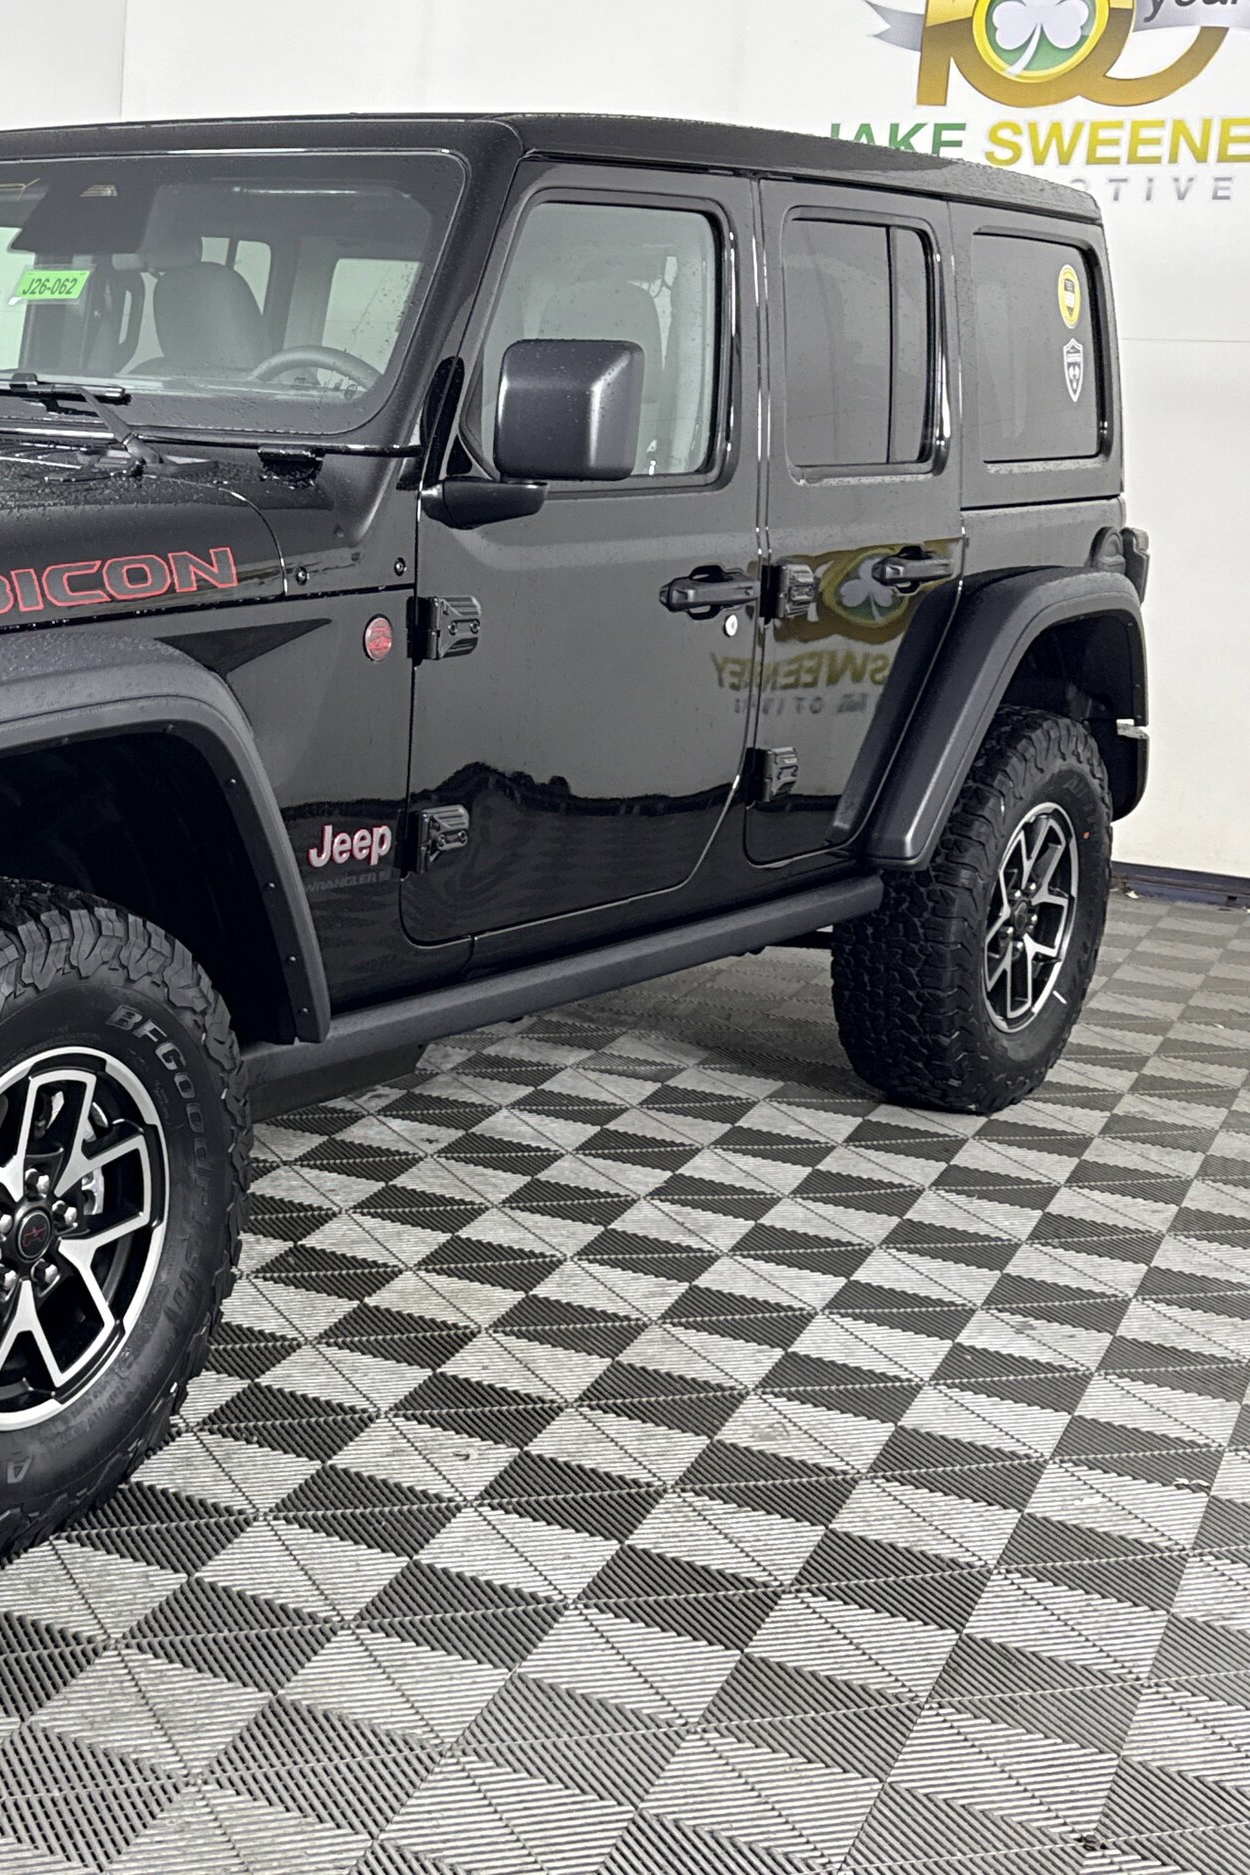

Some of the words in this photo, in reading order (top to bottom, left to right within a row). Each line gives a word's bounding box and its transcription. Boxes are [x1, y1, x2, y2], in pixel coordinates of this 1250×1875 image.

[984, 117, 1250, 167] SWEENE
[21, 277, 78, 296] J26-062
[308, 824, 392, 868] Jeep
